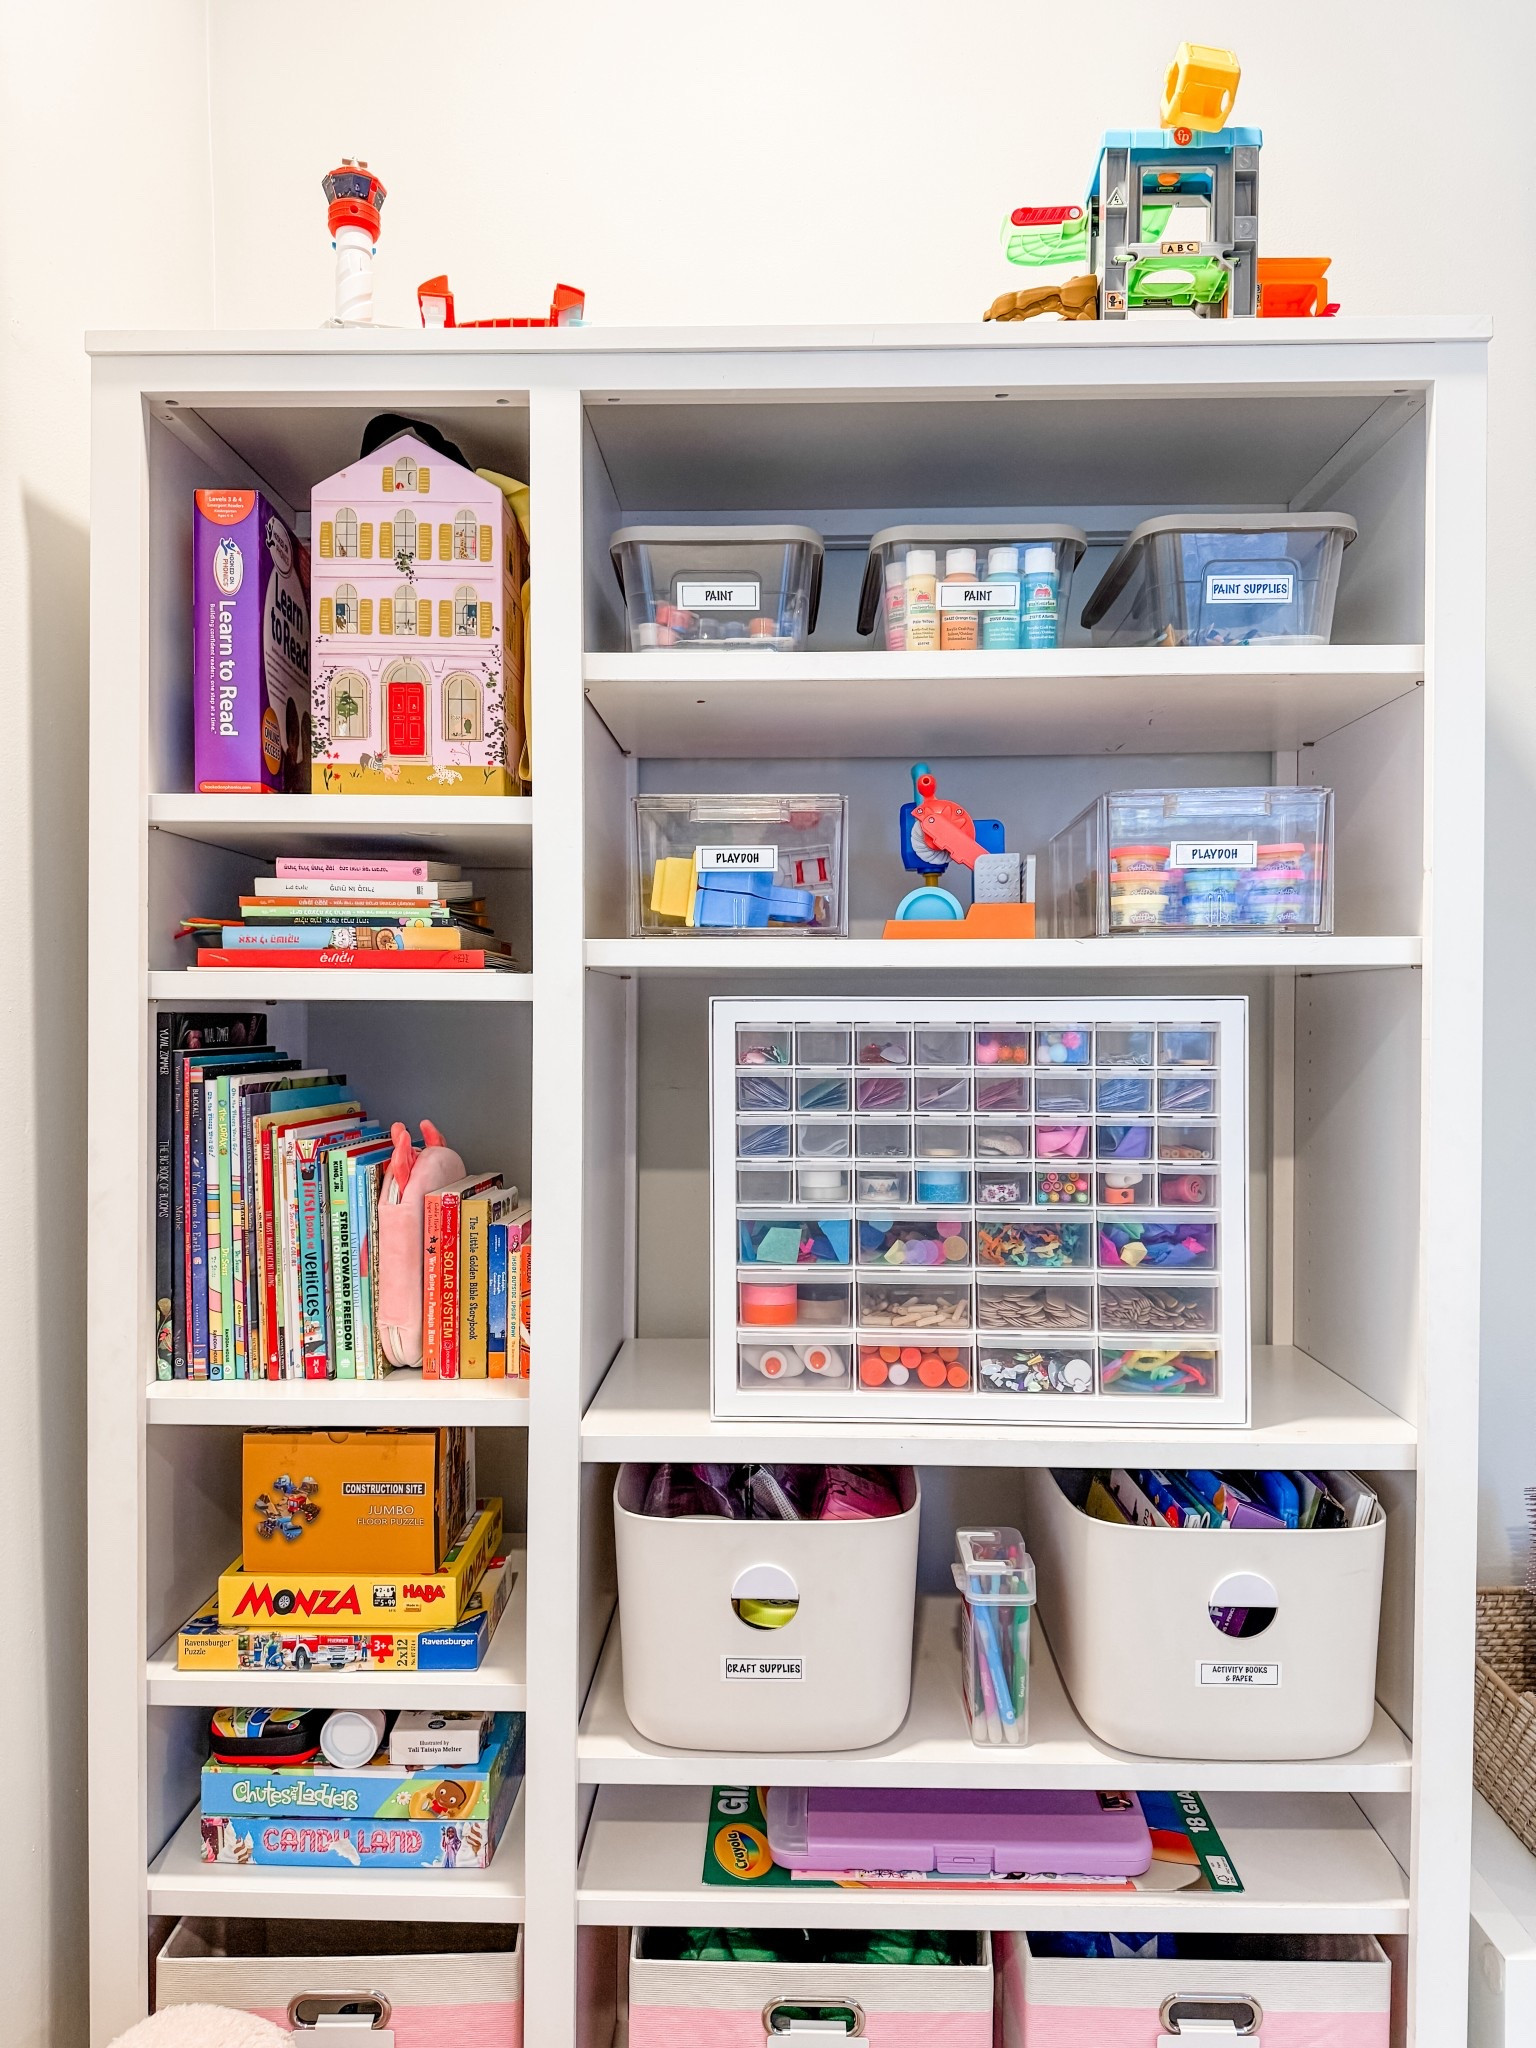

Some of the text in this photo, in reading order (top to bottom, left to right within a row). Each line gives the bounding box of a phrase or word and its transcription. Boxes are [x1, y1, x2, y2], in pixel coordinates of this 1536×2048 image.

[230, 576, 234, 584] ON
[1213, 584, 1288, 595] PAINT SUPPLIES
[275, 572, 304, 630] Learn
[704, 590, 734, 602] PAINT
[964, 590, 993, 602] PAINT
[282, 620, 308, 675] Read
[219, 601, 238, 736] Learn to Read
[265, 726, 280, 746] ONLINE
[715, 853, 760, 865] PLAYDOH
[1192, 848, 1238, 860] PLAYDOH
[160, 1028, 168, 1076] YUVAL ZOMMER
[219, 1108, 228, 1148] The LORAX
[160, 1140, 168, 1217] THE BIG BOOK OF BLOOMS
[192, 1182, 201, 1196] You
[174, 1205, 183, 1230] Maybe
[192, 1198, 201, 1217] Come
[193, 1220, 201, 1228] to
[193, 1232, 202, 1252] Earth
[266, 1236, 274, 1270] MAGNIFICENT
[444, 1251, 454, 1289] SOLAR
[467, 1216, 479, 1340] The Little Golden Bible Storybook
[332, 1212, 344, 1351] THE MONTGOMERY STORY
[340, 1212, 352, 1351] STRIDE TOWARD FREEDOM
[428, 1256, 437, 1344] We're Going Pumpkin Hunt
[444, 1292, 454, 1338] SYSTEM
[346, 1484, 422, 1494] CONSTRUCTION SITE
[368, 1505, 414, 1515] JUMBO
[232, 1582, 361, 1618] MONZA
[402, 1584, 446, 1603] HABA
[184, 1638, 230, 1648] Ravensburger
[373, 1640, 386, 1652] 3+
[422, 1638, 474, 1647] Ravensburger
[396, 1639, 408, 1667] 2x12
[727, 1664, 801, 1674] CRAFT SUPPLIES
[1212, 1666, 1268, 1674] ACTIVITY BOOKS
[1232, 1674, 1254, 1682] PAPER
[232, 1780, 359, 1812] Chutes Ladders
[1186, 1816, 1210, 1833] 18
[357, 1828, 424, 1854] LAND
[727, 1830, 748, 1869] Crayola
